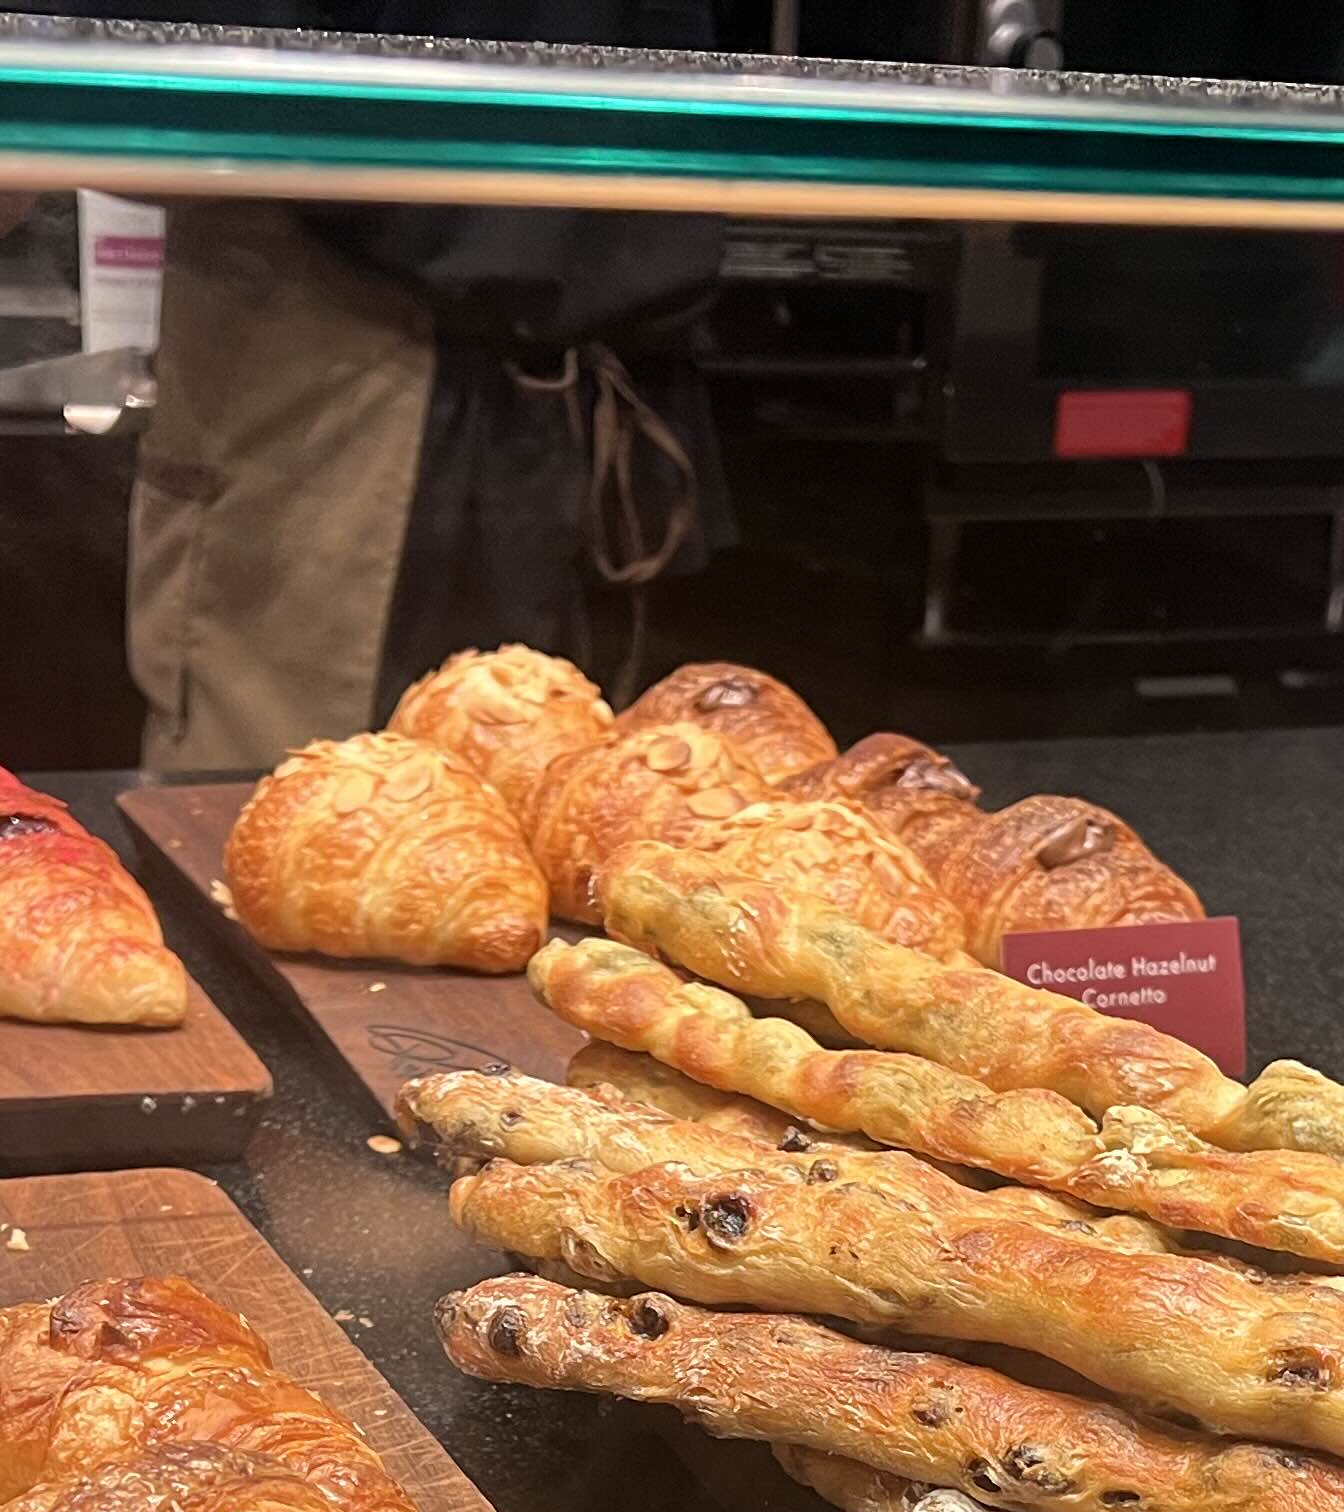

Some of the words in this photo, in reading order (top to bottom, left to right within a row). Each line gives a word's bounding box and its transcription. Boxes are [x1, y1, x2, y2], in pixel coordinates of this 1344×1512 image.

[1026, 957, 1126, 985] Chocolate
[1131, 951, 1217, 977] Hazelnut
[1082, 988, 1167, 1009] Cornetto
